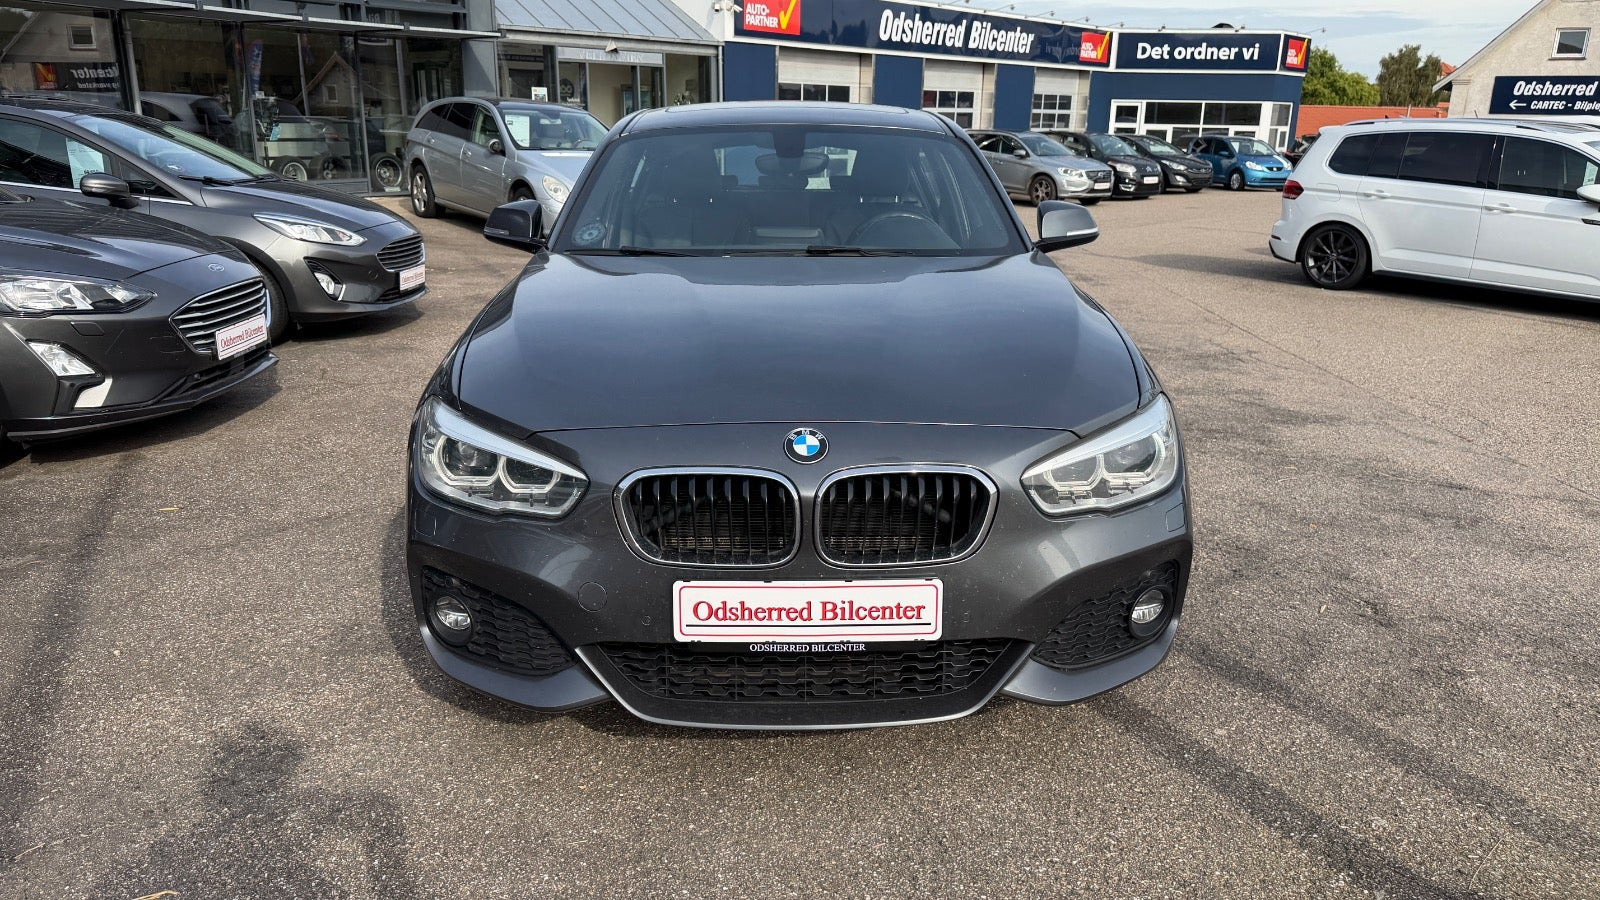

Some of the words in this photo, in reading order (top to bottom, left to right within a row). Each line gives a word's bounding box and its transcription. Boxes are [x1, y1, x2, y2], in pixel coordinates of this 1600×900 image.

[746, 2, 770, 16] AUTO-
[745, 14, 779, 29] PARTNER
[879, 9, 967, 48] Odsherred
[969, 20, 1035, 54] Bilcenter
[1137, 42, 1171, 60] Det
[1174, 41, 1238, 61] ordner
[1243, 43, 1259, 61] vi
[1513, 80, 1599, 96] Odsherred
[1530, 100, 1566, 110] CARTEC
[1573, 100, 1600, 112] Bilple
[788, 429, 823, 440] BMW
[692, 600, 813, 622] Odsherred
[819, 599, 926, 621] Bilcenter
[749, 643, 810, 652] ODSHERRED
[811, 643, 866, 652] BILCENTER
